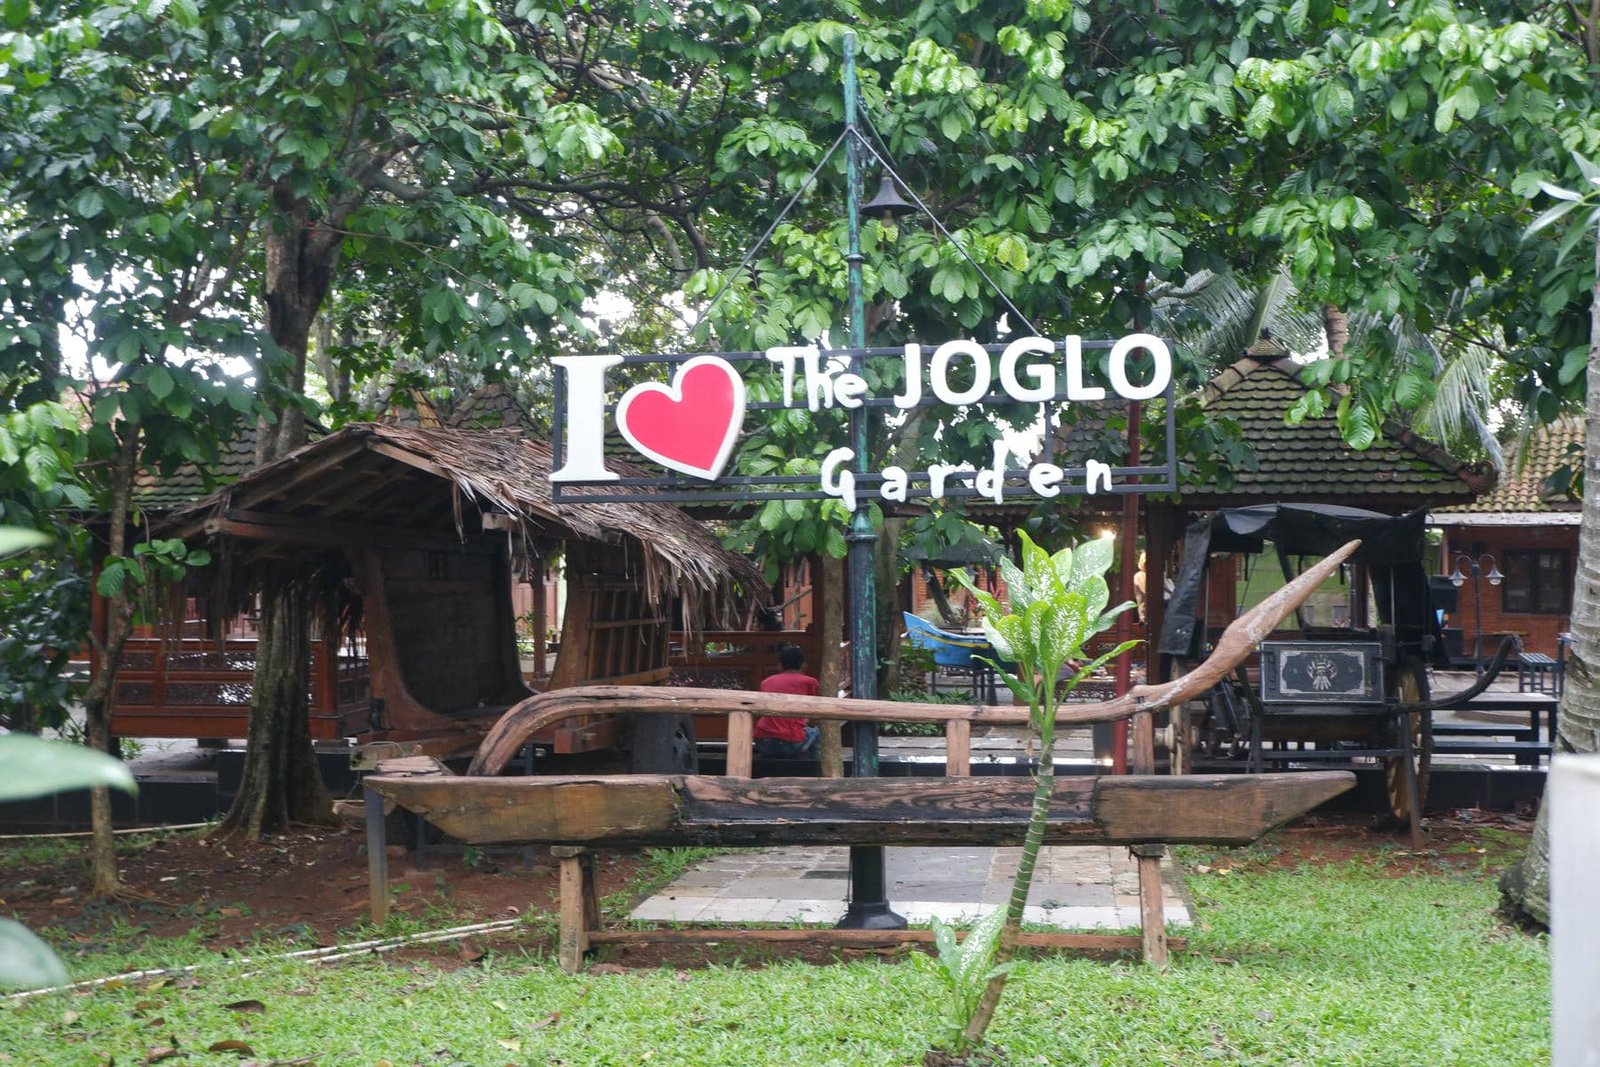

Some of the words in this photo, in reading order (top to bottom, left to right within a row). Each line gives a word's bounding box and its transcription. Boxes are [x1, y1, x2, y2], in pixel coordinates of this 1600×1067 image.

[548, 355, 623, 482] I
[766, 346, 868, 412] The
[893, 333, 1172, 409] JOGLO
[821, 439, 1113, 511] Garden
